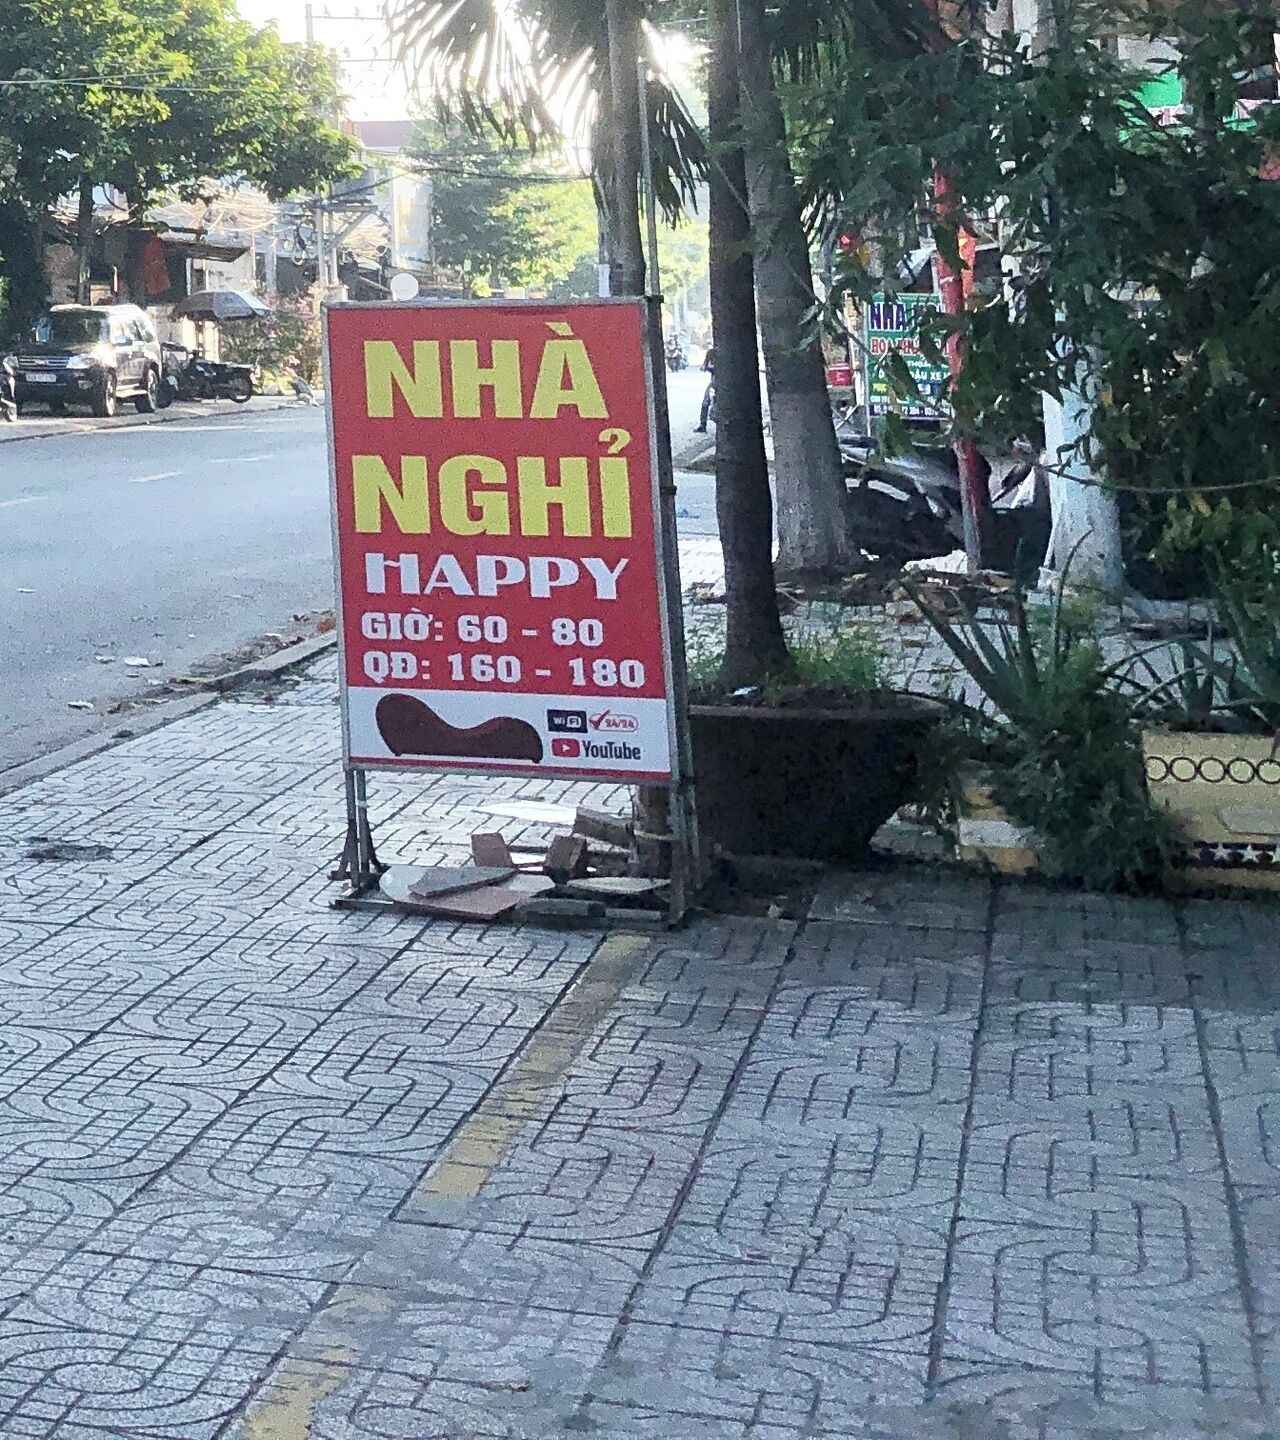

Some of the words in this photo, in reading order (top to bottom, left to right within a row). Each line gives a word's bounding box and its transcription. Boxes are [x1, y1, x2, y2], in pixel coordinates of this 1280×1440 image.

[363, 321, 609, 420] NHÀ
[351, 426, 633, 539] NGHỈ
[364, 551, 630, 601] HAPPY
[360, 606, 444, 643] GIỜ:
[456, 613, 509, 644] 60
[550, 616, 605, 648] 80
[362, 649, 431, 684] QĐ:
[446, 652, 523, 684] 160
[568, 656, 646, 689] 180
[582, 739, 641, 760] YouTube
